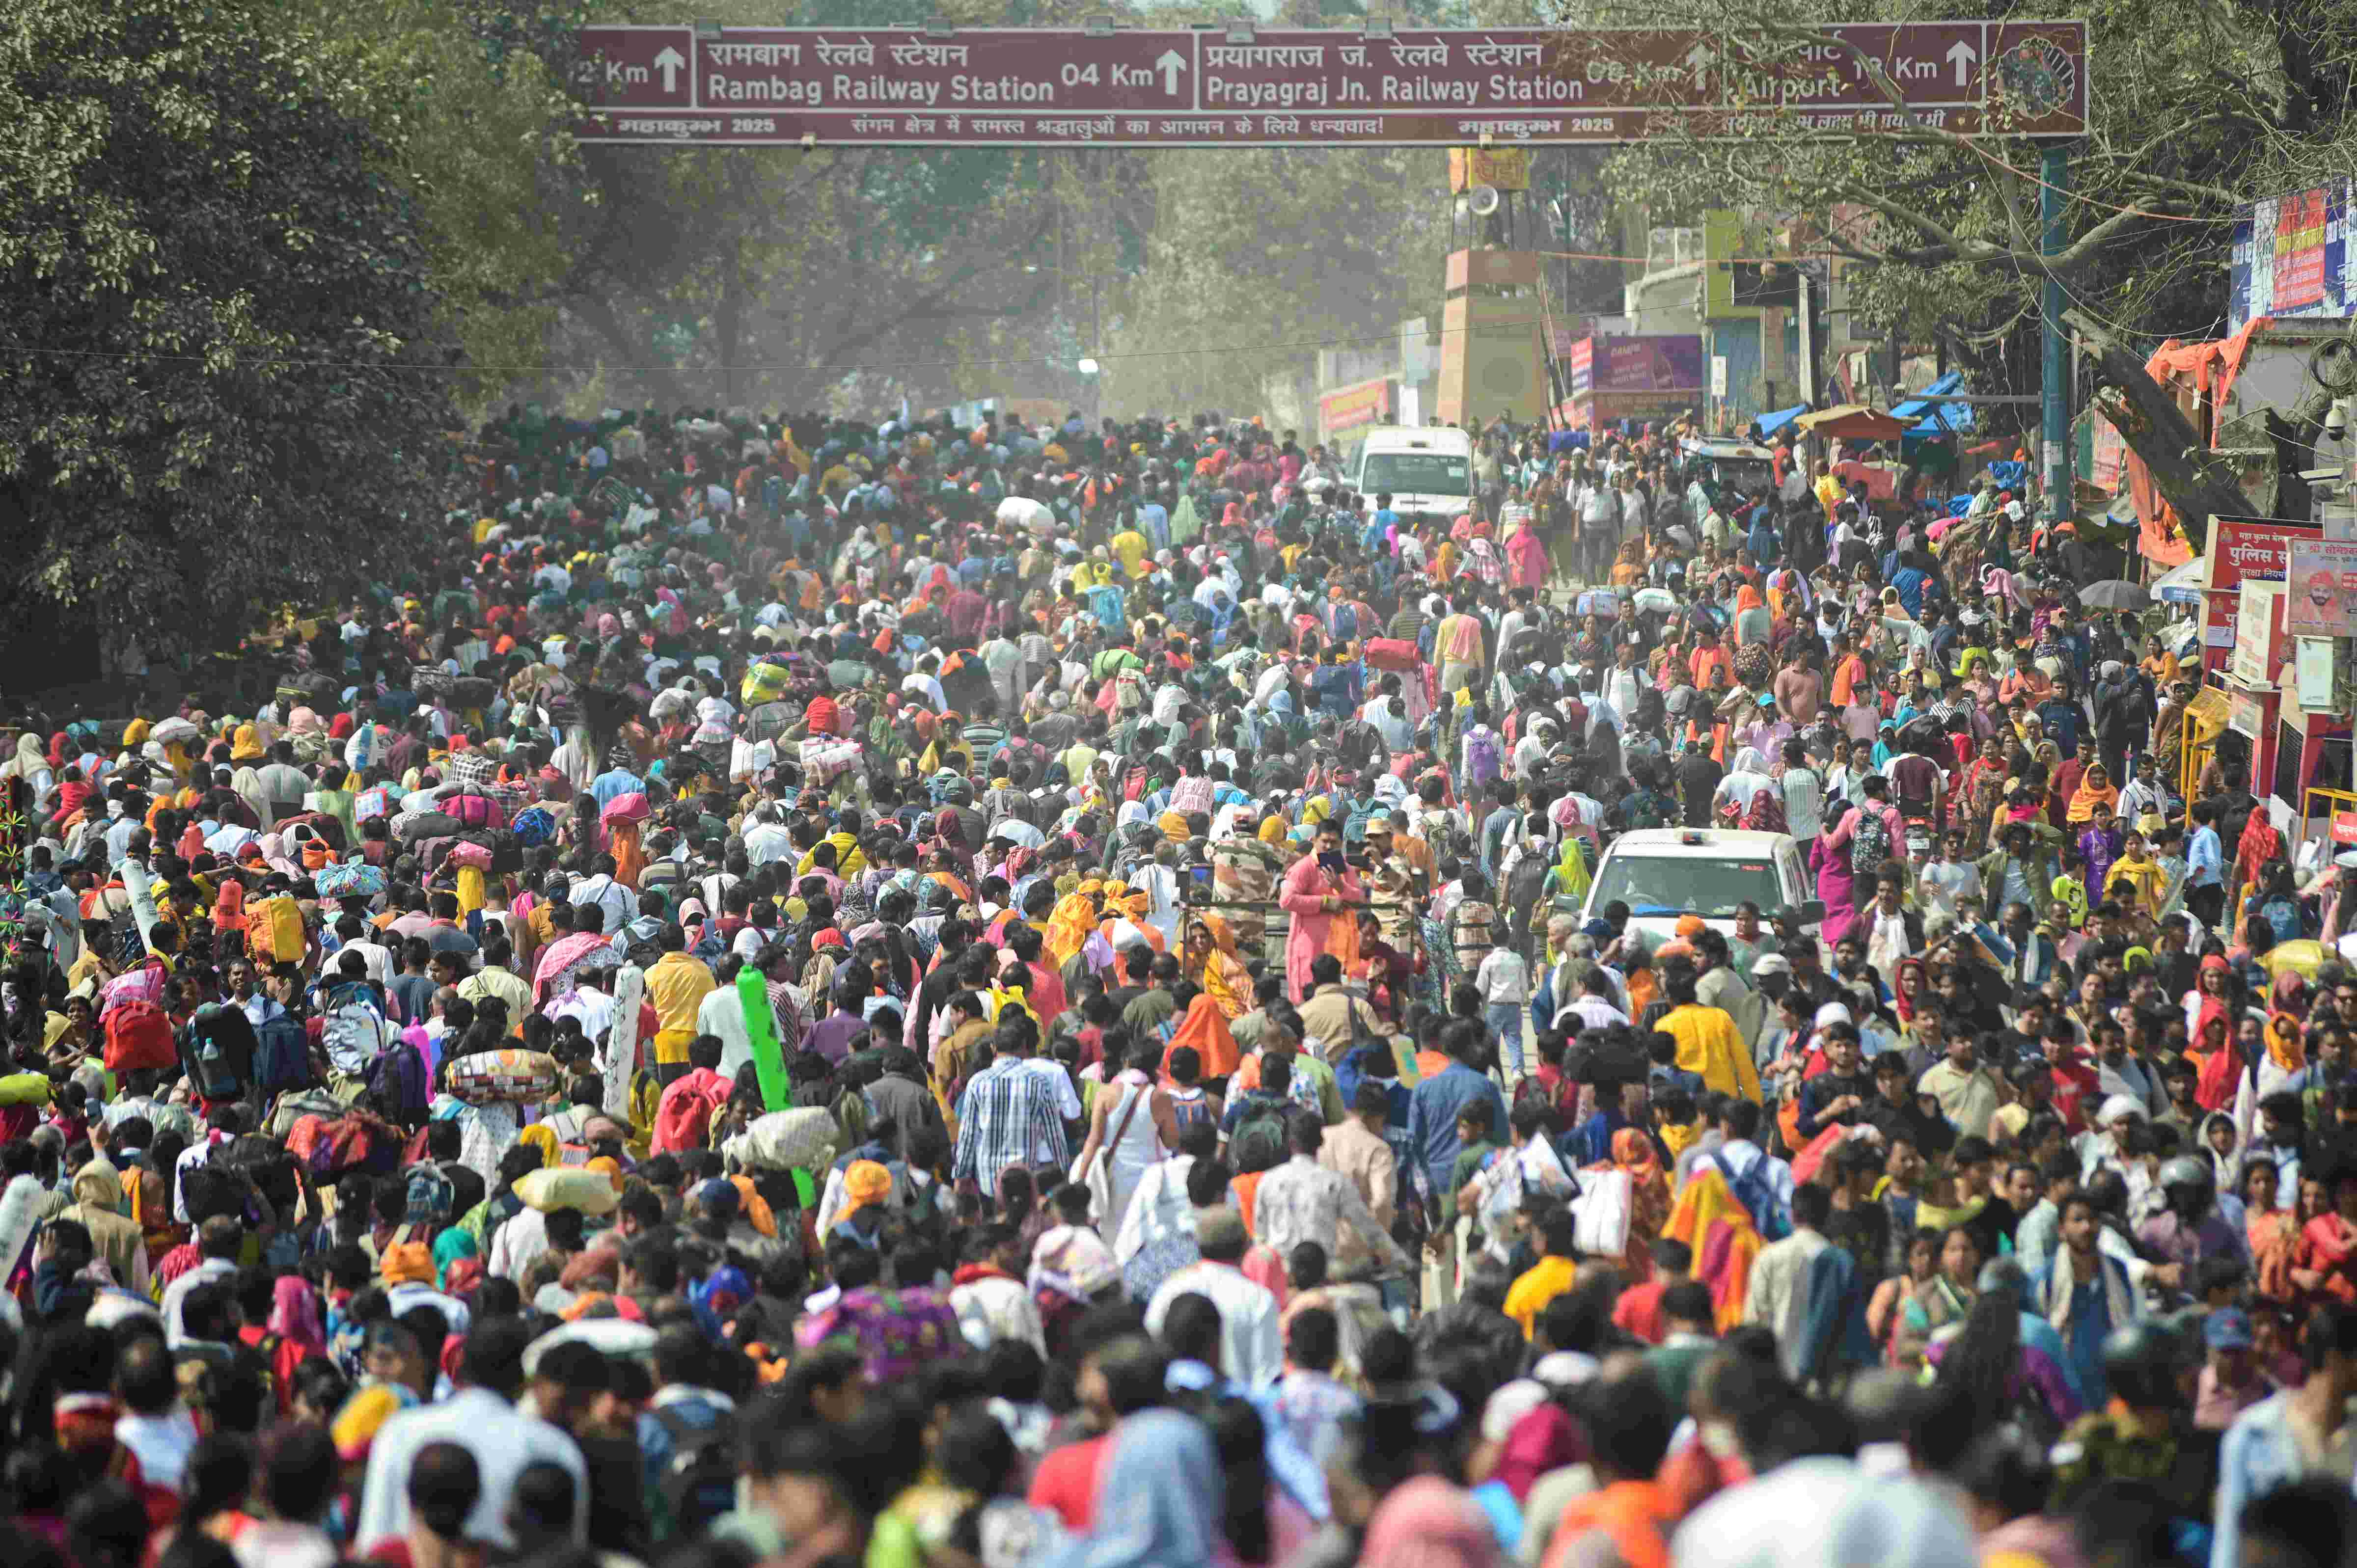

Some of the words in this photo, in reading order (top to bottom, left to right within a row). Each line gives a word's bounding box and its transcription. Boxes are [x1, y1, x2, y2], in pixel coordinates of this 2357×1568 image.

[707, 43, 800, 66] रामबाग
[815, 36, 874, 66] रेलवे
[890, 36, 968, 66] स्टेशन
[1206, 46, 1324, 68] प्रयागराज
[1390, 37, 1449, 66] रेलवे
[1464, 36, 1543, 66] स्टेशन
[606, 60, 649, 83] Km
[709, 74, 822, 104] Rambag
[834, 75, 940, 105] Railway
[951, 75, 1054, 101] Station
[1061, 63, 1099, 86] 04
[1111, 63, 1153, 86] Km
[1743, 73, 1840, 105] Airport
[1896, 56, 1937, 79] Km
[1207, 77, 1327, 106] Prayagraj
[1336, 76, 1371, 101] Jn.
[1382, 76, 1479, 106] Railway
[1489, 75, 1583, 101] Station
[732, 118, 775, 133] 2025
[905, 114, 935, 133] क्षेत्र
[946, 114, 960, 133] में
[972, 119, 1025, 134] समस्त
[1127, 119, 1149, 134] का
[1160, 119, 1224, 134] आगमन
[1234, 116, 1252, 134] के
[1264, 116, 1299, 134] लिये
[1571, 118, 1614, 132] 2025
[2229, 542, 2273, 566] पुलिस
